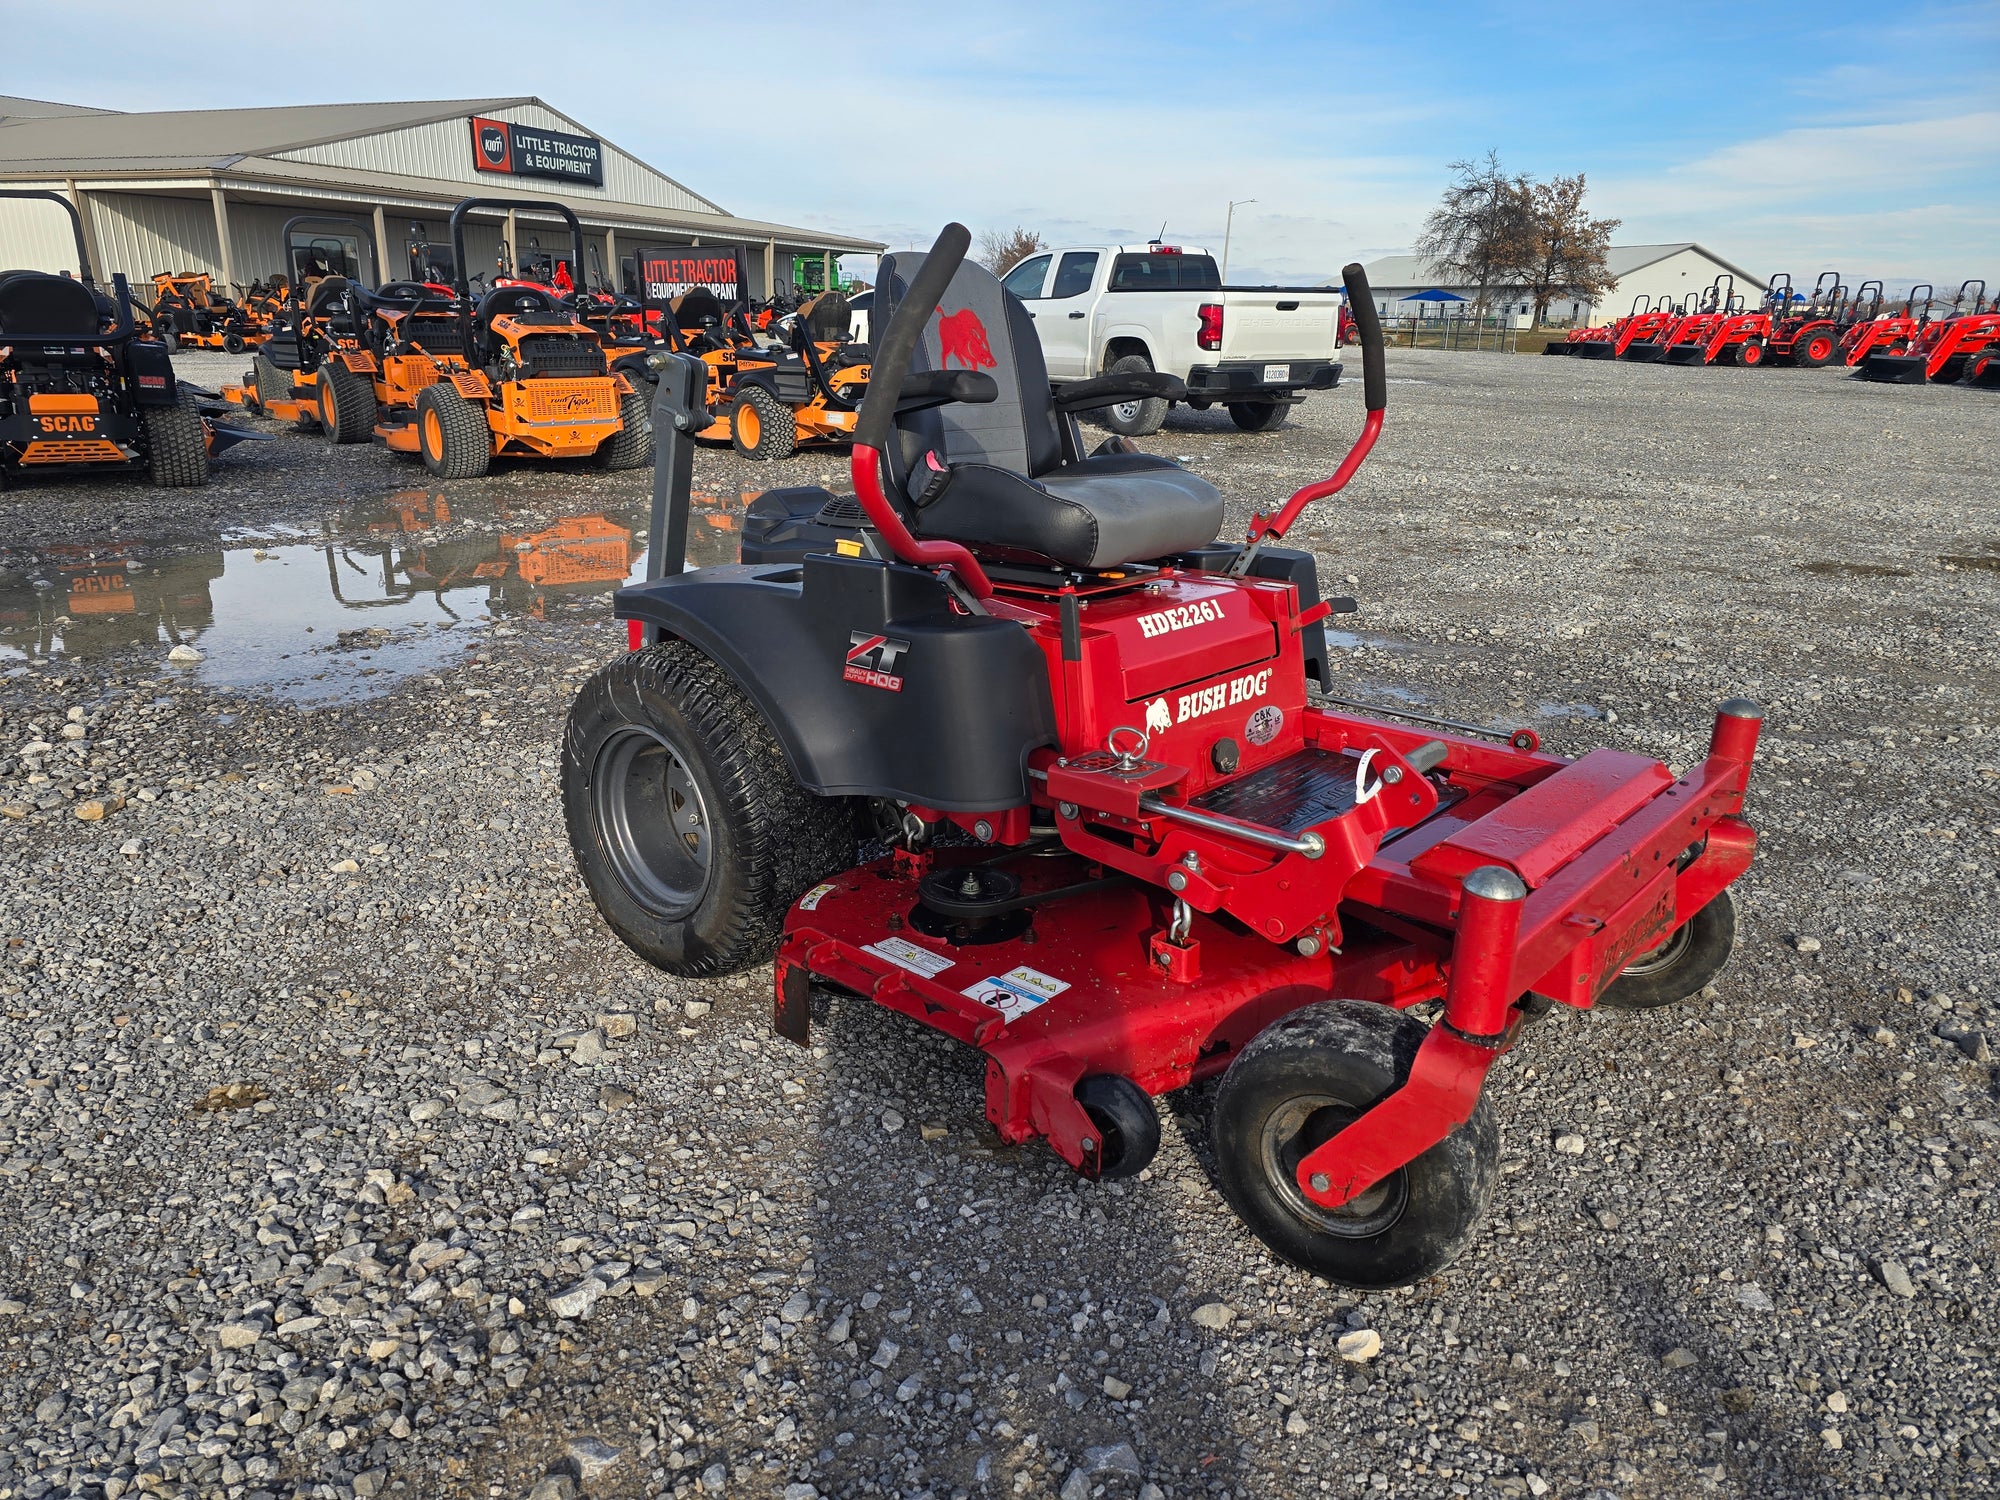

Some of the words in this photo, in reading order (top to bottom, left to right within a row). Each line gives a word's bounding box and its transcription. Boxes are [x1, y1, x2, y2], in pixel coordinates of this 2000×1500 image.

[516, 135, 551, 153] LITTLE
[553, 142, 598, 160] TRACTOR
[526, 154, 533, 166] &
[536, 155, 592, 175] EQUIPMENT
[643, 260, 679, 283] LITTLE
[681, 259, 738, 283] TRACTOR
[645, 282, 651, 300] &
[652, 282, 695, 299] EQUIPMEN
[1239, 318, 1331, 328] CHEVROLET
[139, 376, 165, 385] SCAG
[40, 416, 95, 432] SCAG
[1136, 599, 1225, 638] HDE2261
[845, 630, 911, 674] ZT
[866, 671, 900, 690] HOG
[1177, 683, 1227, 723] BUSH
[1254, 707, 1272, 723] C&K
